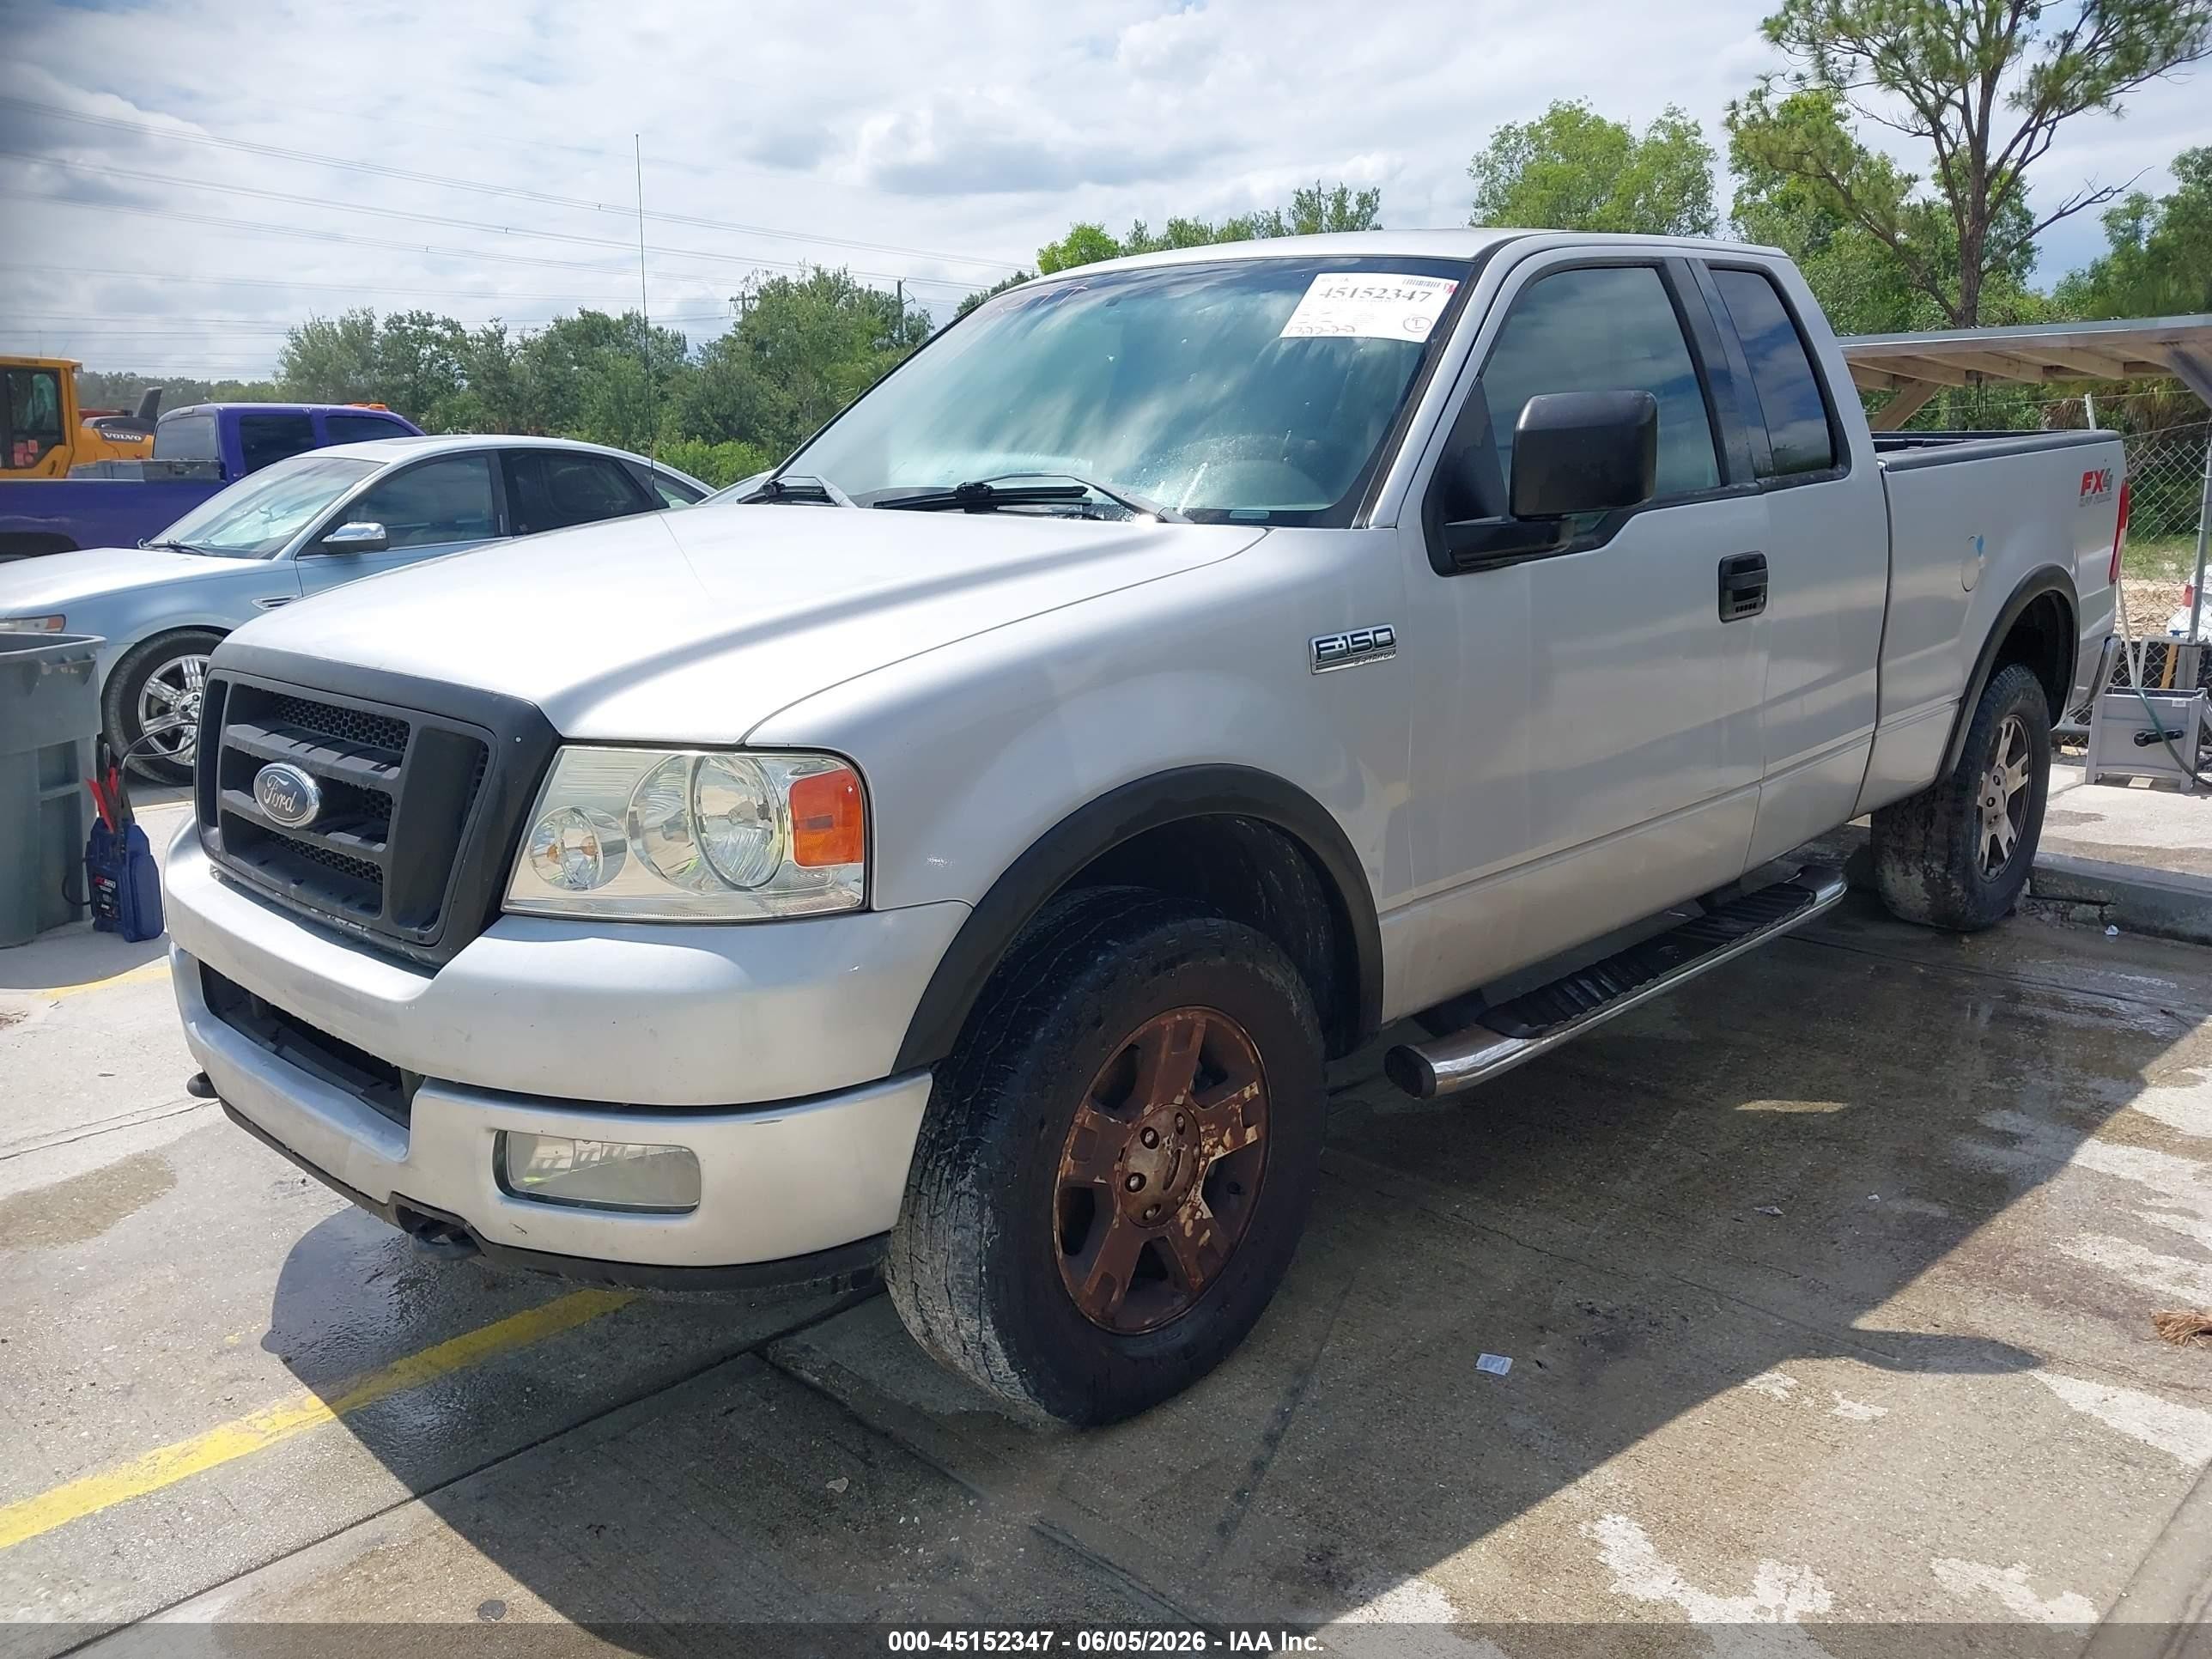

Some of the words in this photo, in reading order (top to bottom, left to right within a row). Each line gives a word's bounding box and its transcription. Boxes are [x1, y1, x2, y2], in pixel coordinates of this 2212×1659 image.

[1320, 287, 1433, 302] 45152347
[103, 432, 142, 441] VOLVO
[2081, 468, 2113, 496] FX4
[264, 775, 296, 811] Ford
